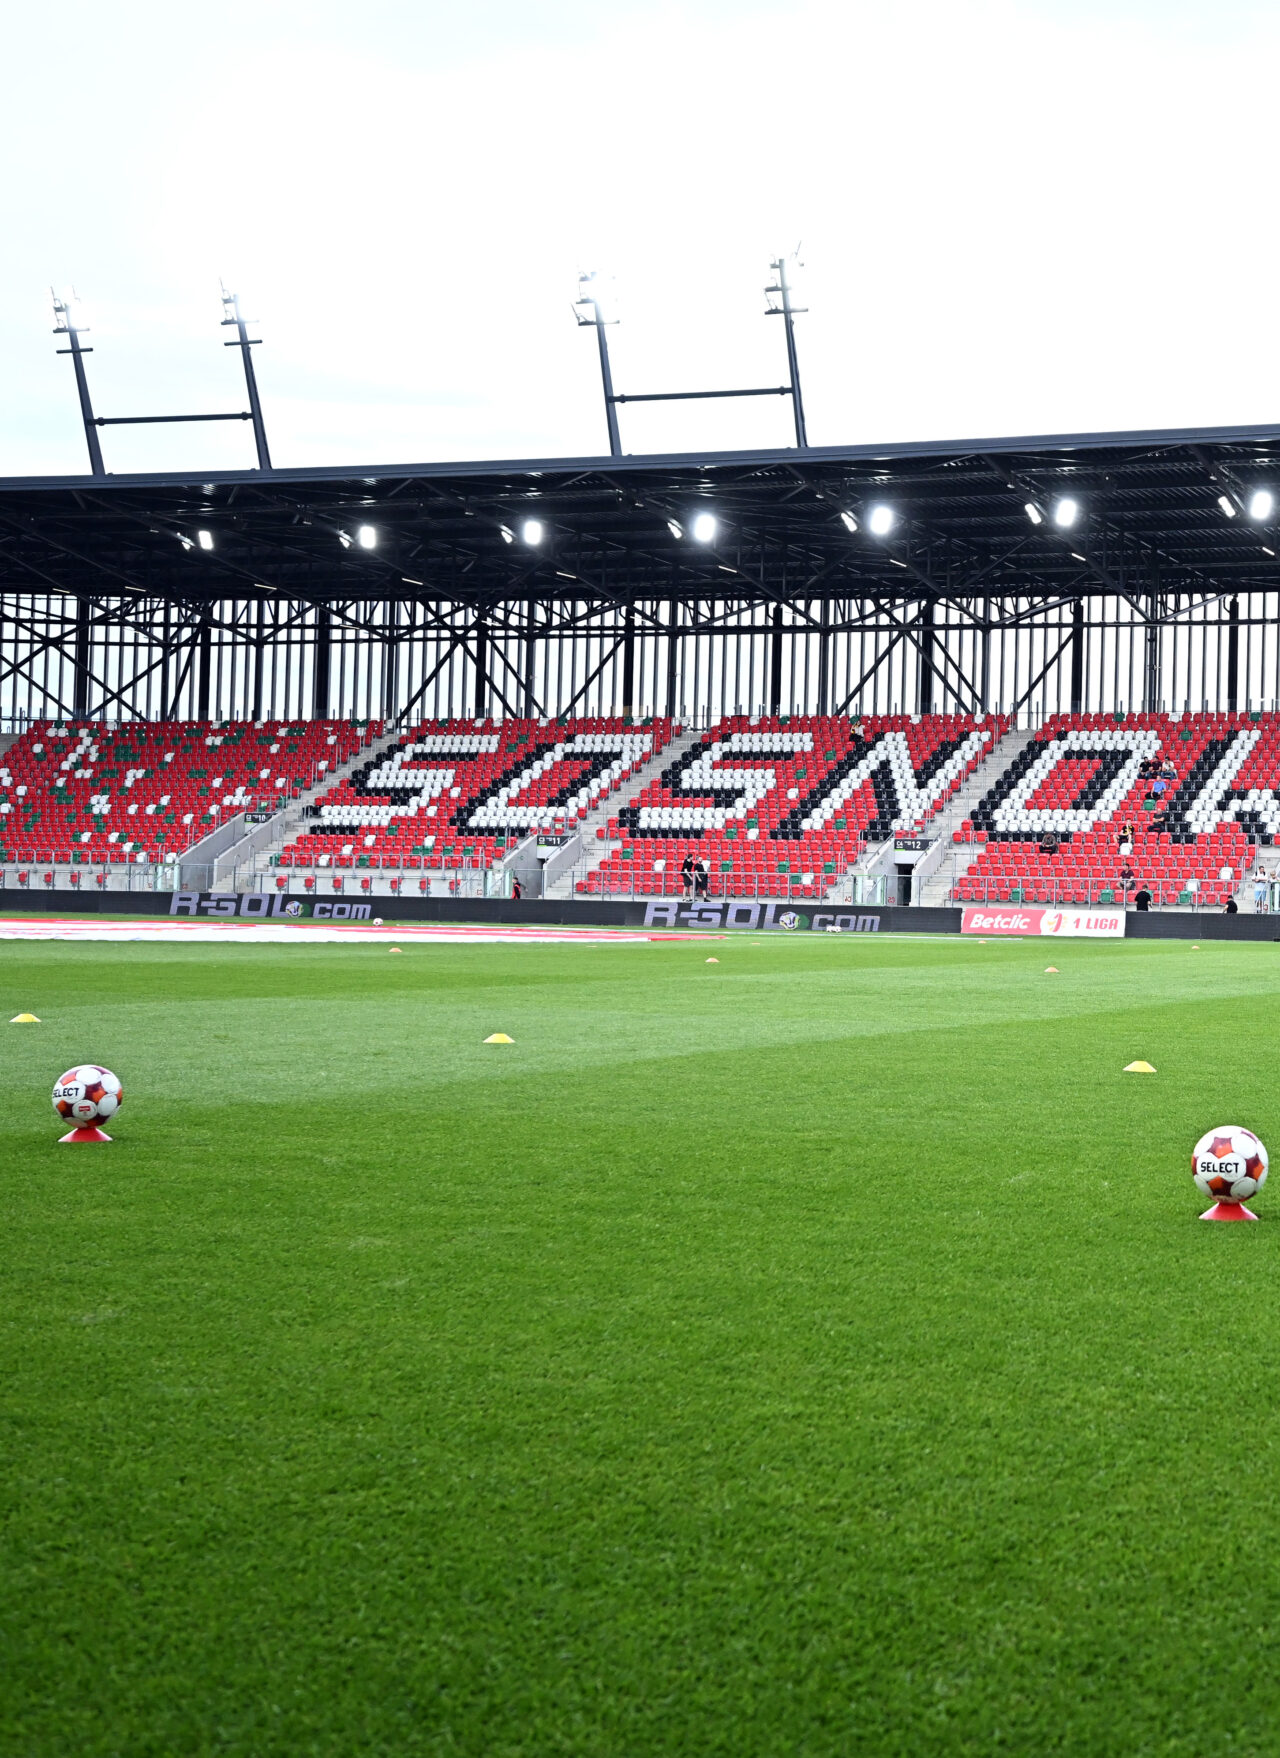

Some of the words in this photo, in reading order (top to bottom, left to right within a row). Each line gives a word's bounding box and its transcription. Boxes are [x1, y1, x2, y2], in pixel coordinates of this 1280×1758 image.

[911, 841, 922, 849] 12
[969, 913, 1032, 930] Betclic
[1073, 917, 1081, 929] 1
[1085, 917, 1119, 930] LIGA
[1200, 1161, 1240, 1174] SELECT
